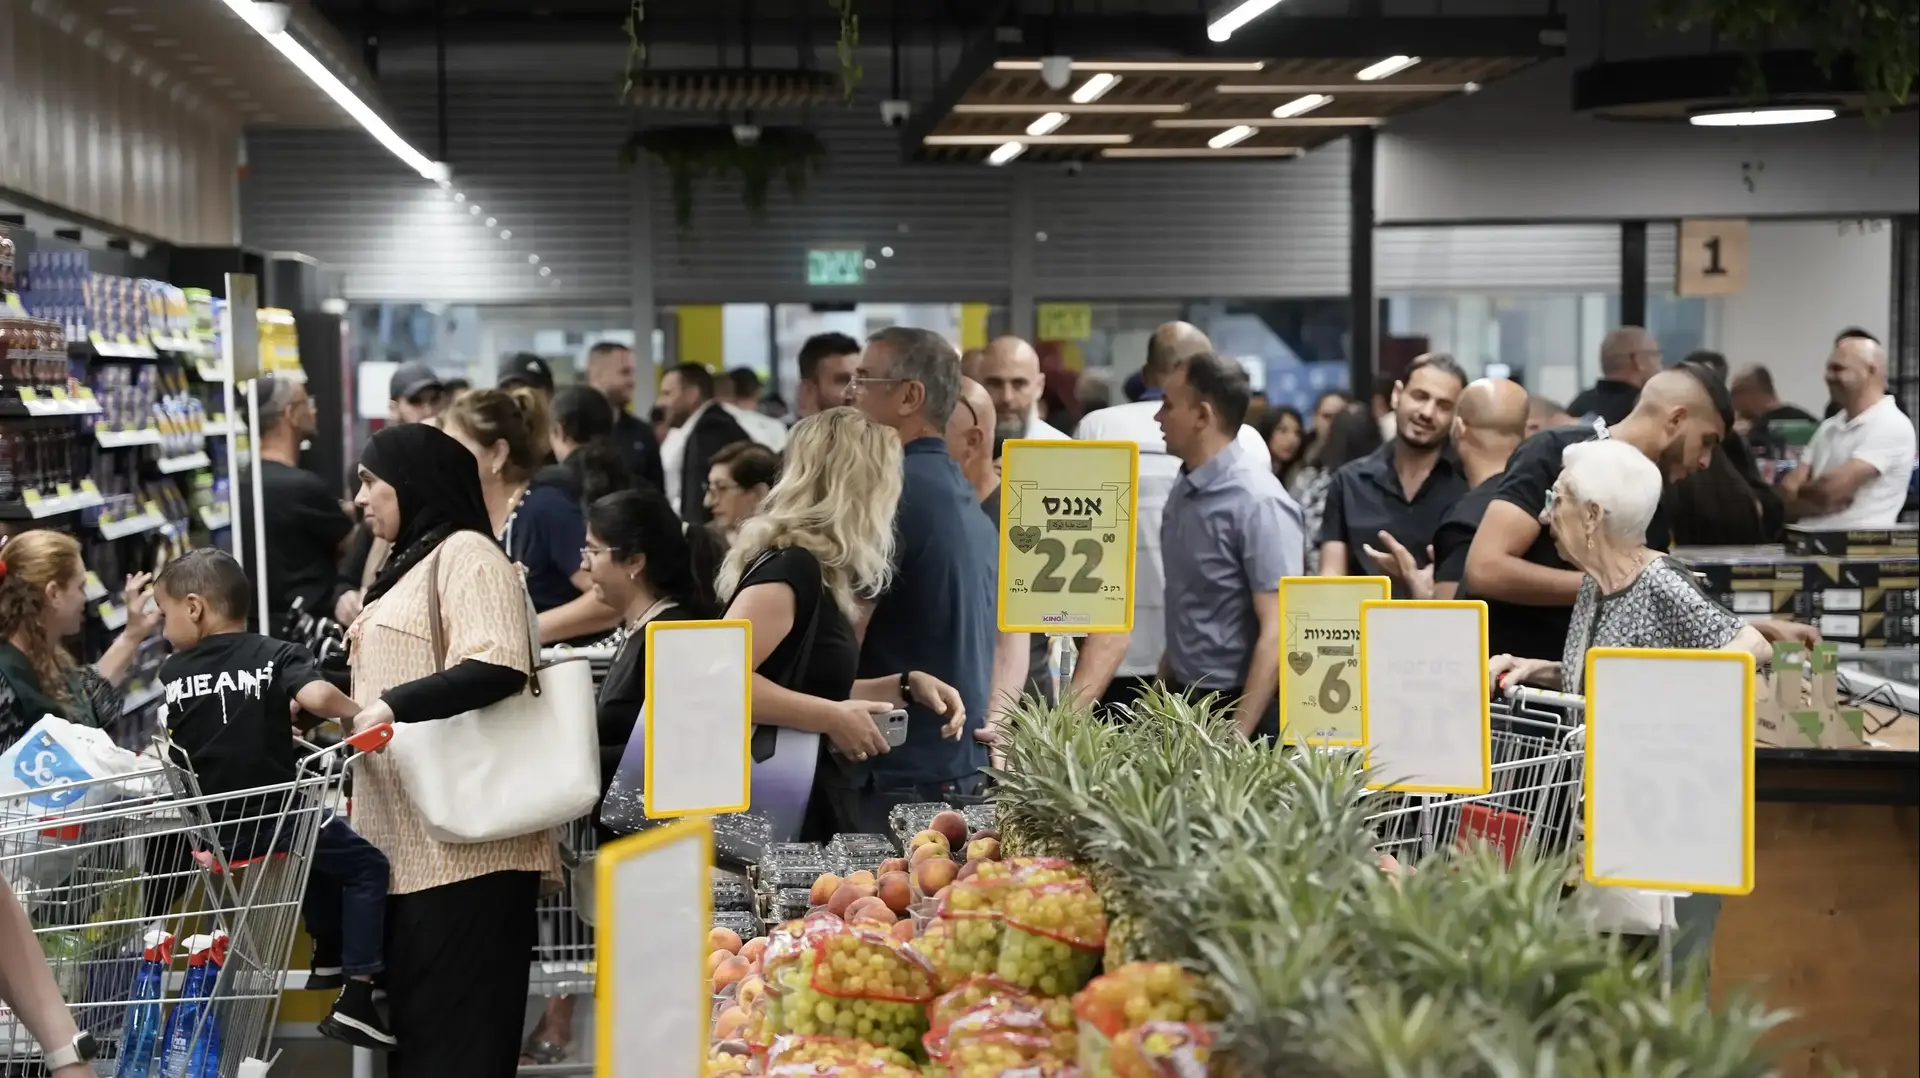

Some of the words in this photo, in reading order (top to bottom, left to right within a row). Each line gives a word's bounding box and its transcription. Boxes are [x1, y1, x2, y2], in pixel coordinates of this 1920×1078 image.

[1702, 235, 1728, 275] 1
[1042, 496, 1102, 516] אננס
[1103, 533, 1116, 543] 00
[1031, 538, 1104, 593] 22
[1110, 585, 1121, 593] רק
[1347, 658, 1358, 668] 90
[1318, 661, 1352, 714] 6
